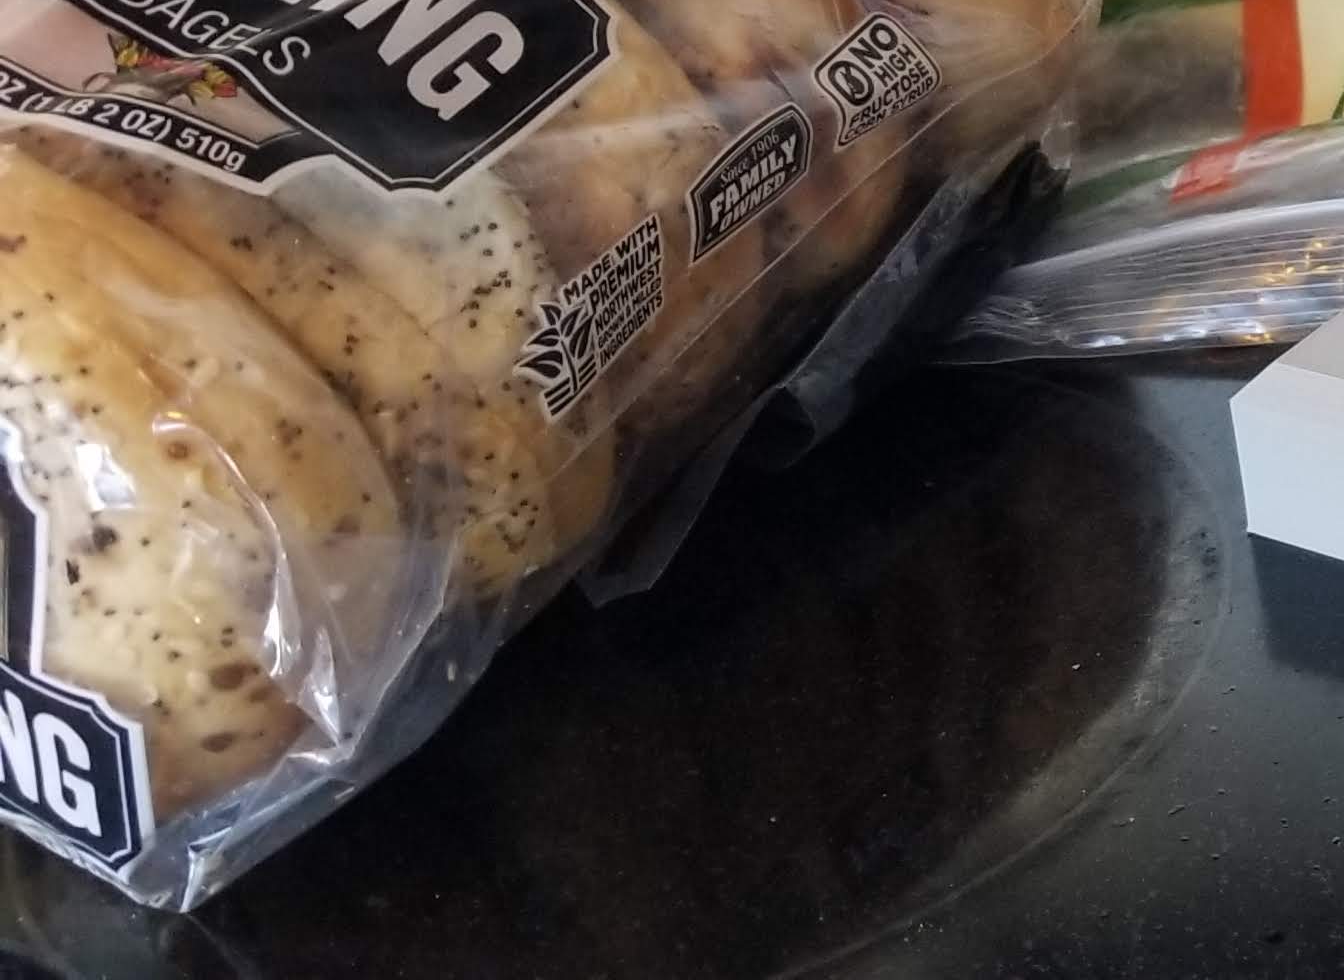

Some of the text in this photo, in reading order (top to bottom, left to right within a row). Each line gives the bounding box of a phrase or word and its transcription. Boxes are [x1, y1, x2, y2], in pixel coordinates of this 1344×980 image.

[848, 23, 898, 70] NO
[872, 43, 917, 88] HIGH
[849, 61, 930, 128] FRUCTOSE
[50, 96, 95, 115] LB
[93, 103, 121, 124] 2
[121, 108, 173, 142] OZ)
[175, 127, 247, 172] 510g
[720, 128, 780, 188] Since 1906
[709, 134, 797, 229] FAMILY
[719, 170, 786, 233] OWNED
[563, 215, 659, 305] MADE WITH
[589, 235, 661, 314] PREMIUM
[594, 257, 662, 336] NORTHWEST
[598, 310, 626, 348] GROWN
[632, 276, 662, 312] MILLED
[600, 289, 663, 366] INGREDIENTS
